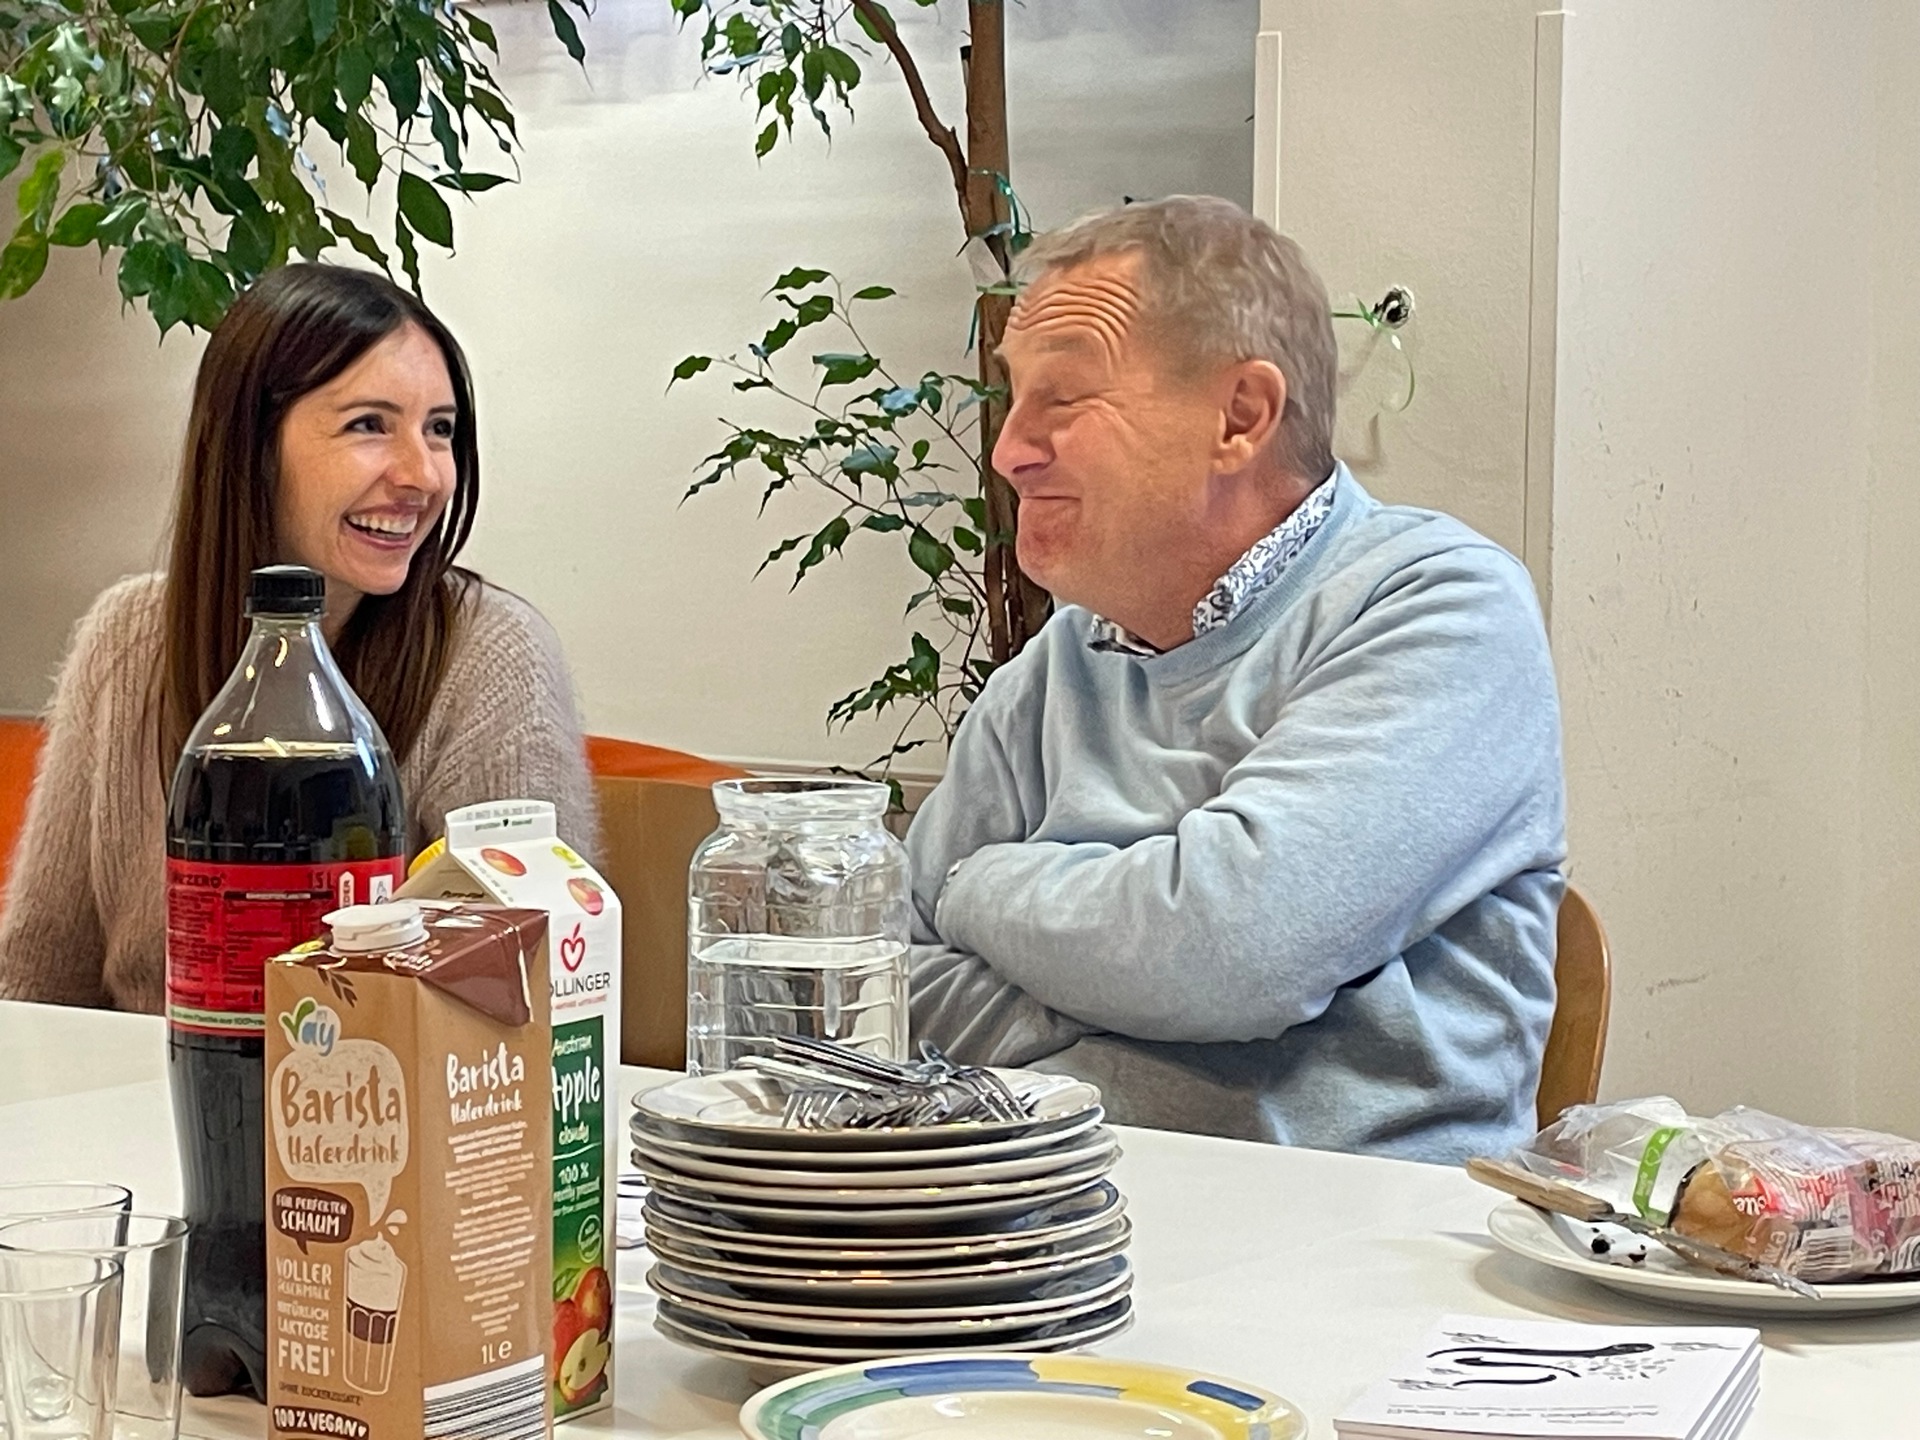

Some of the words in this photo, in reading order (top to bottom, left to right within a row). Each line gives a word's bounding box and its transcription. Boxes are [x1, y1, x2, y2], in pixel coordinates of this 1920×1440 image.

[447, 1042, 525, 1099] Barista
[281, 1065, 400, 1129] Barista
[451, 1089, 523, 1126] Haferdrink
[288, 1133, 400, 1166] Haferdrink
[281, 1209, 340, 1237] SCHAUM
[276, 1257, 332, 1286] VOLLER
[278, 1319, 330, 1342] LAKTOSE
[308, 1412, 358, 1438] VEGAN
